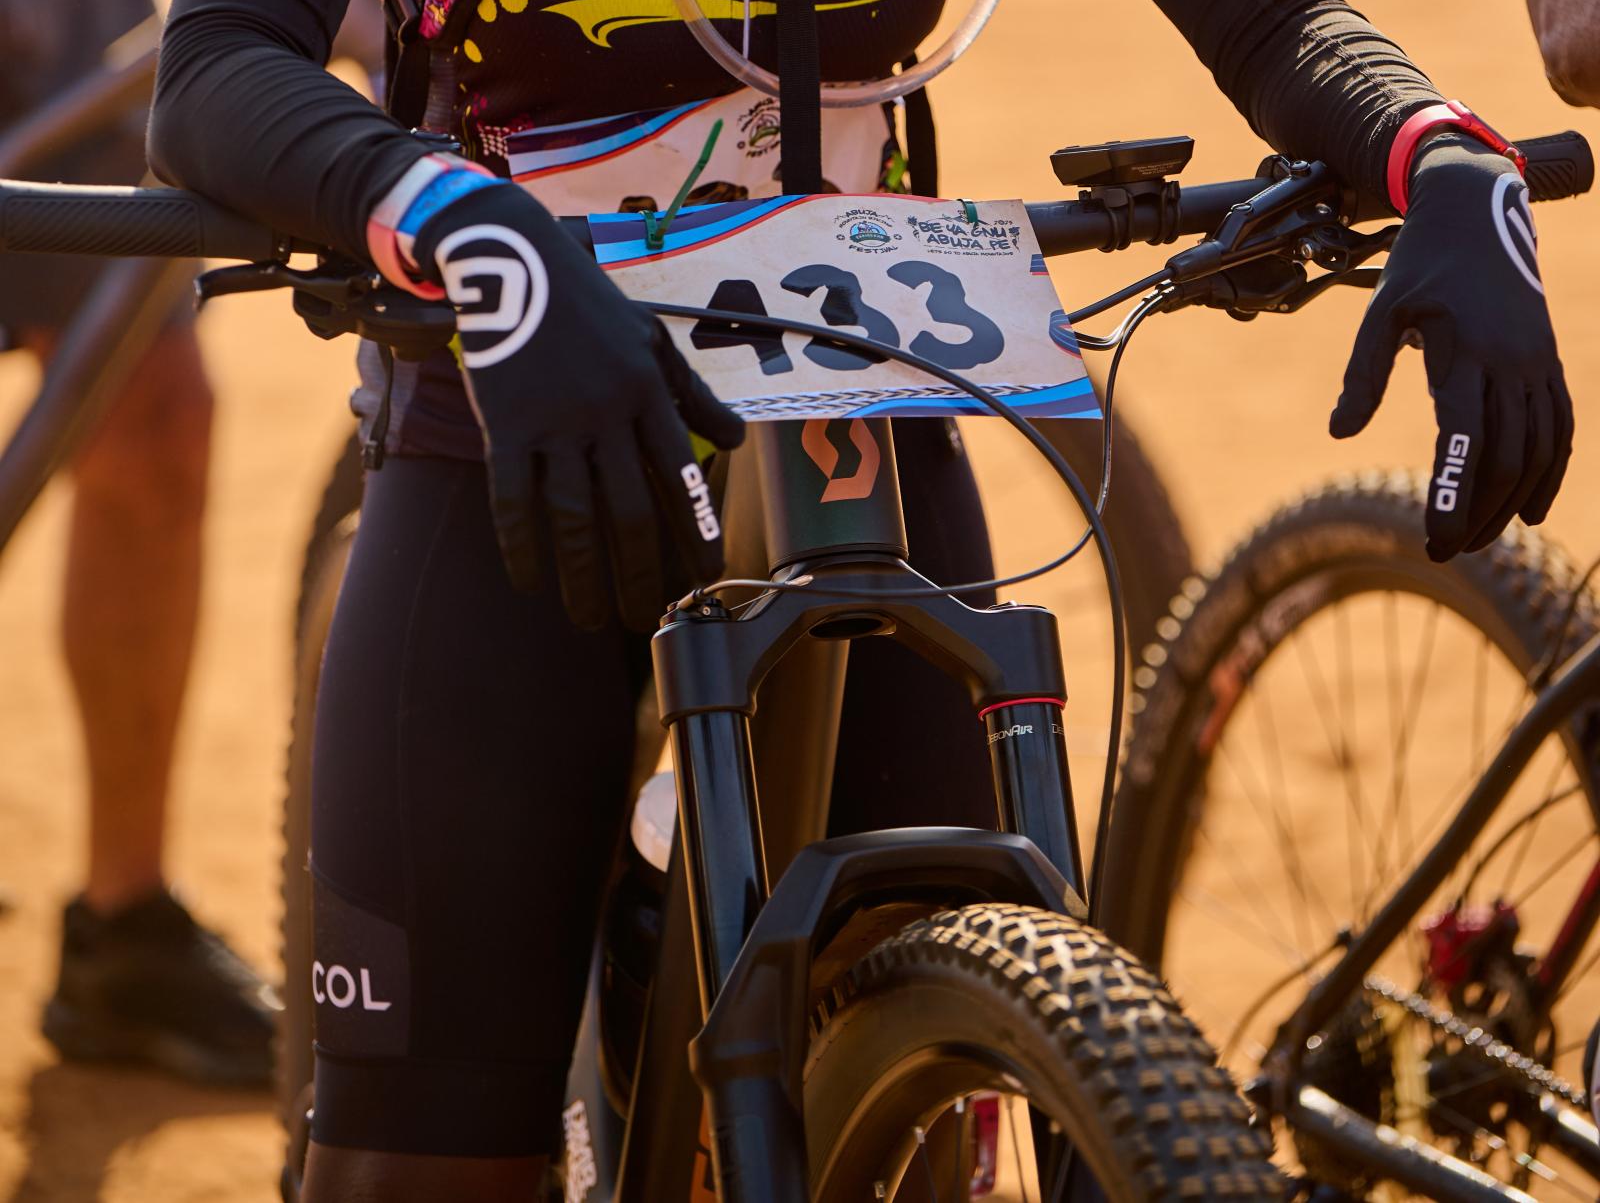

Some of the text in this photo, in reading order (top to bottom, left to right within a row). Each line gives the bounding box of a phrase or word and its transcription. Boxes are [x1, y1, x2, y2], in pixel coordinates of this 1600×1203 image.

[845, 209, 878, 218] ABUJA
[918, 221, 943, 234] BE
[848, 244, 898, 254] FESTIVAL
[927, 234, 1011, 251] ABUJA PE
[690, 260, 1005, 375] 433
[1436, 433, 1470, 512] GIYO
[681, 462, 720, 541] GIYO
[312, 960, 392, 1011] COL
